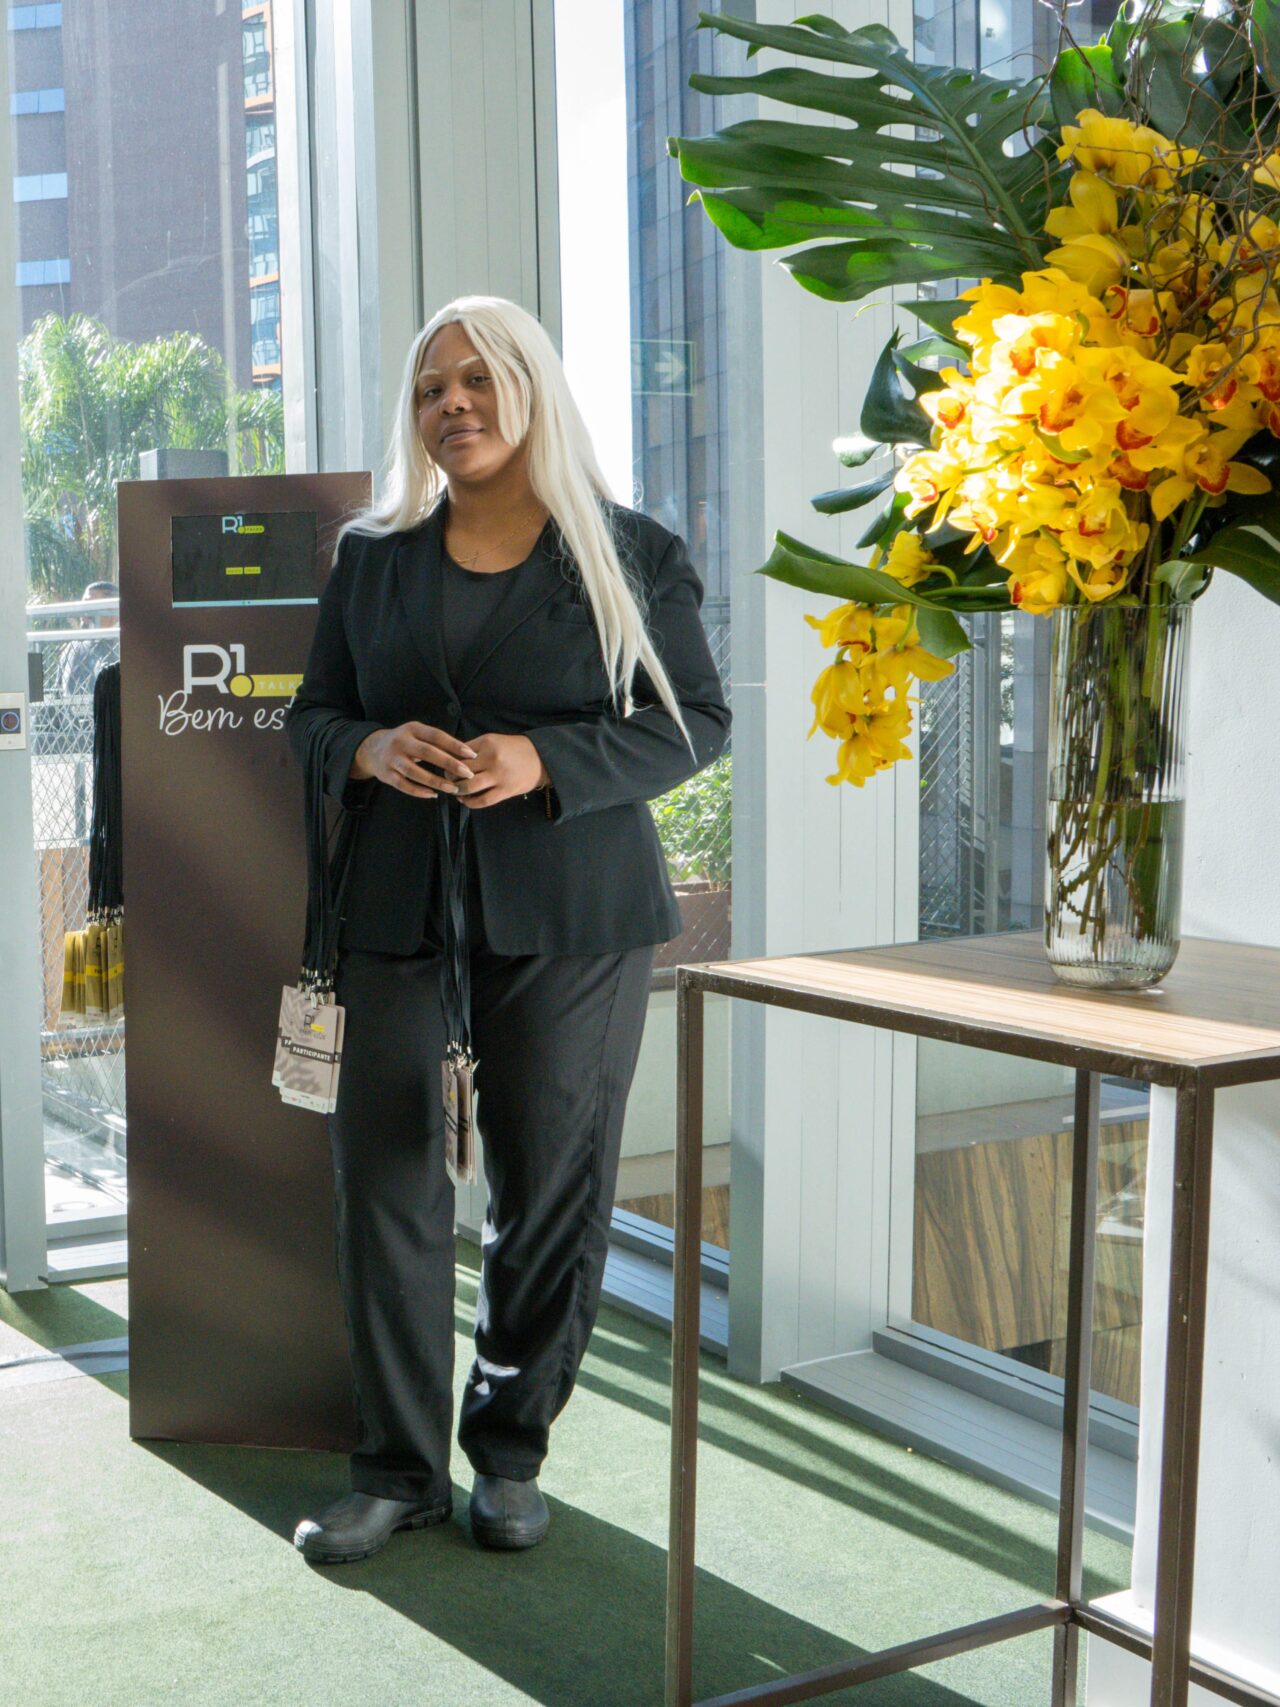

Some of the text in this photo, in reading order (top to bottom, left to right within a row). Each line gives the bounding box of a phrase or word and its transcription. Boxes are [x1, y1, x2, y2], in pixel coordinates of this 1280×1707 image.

[183, 643, 245, 694] R1
[259, 681, 297, 690] TALK
[158, 690, 292, 736] Bem es
[292, 1046, 331, 1061] PARTICIPANTE
